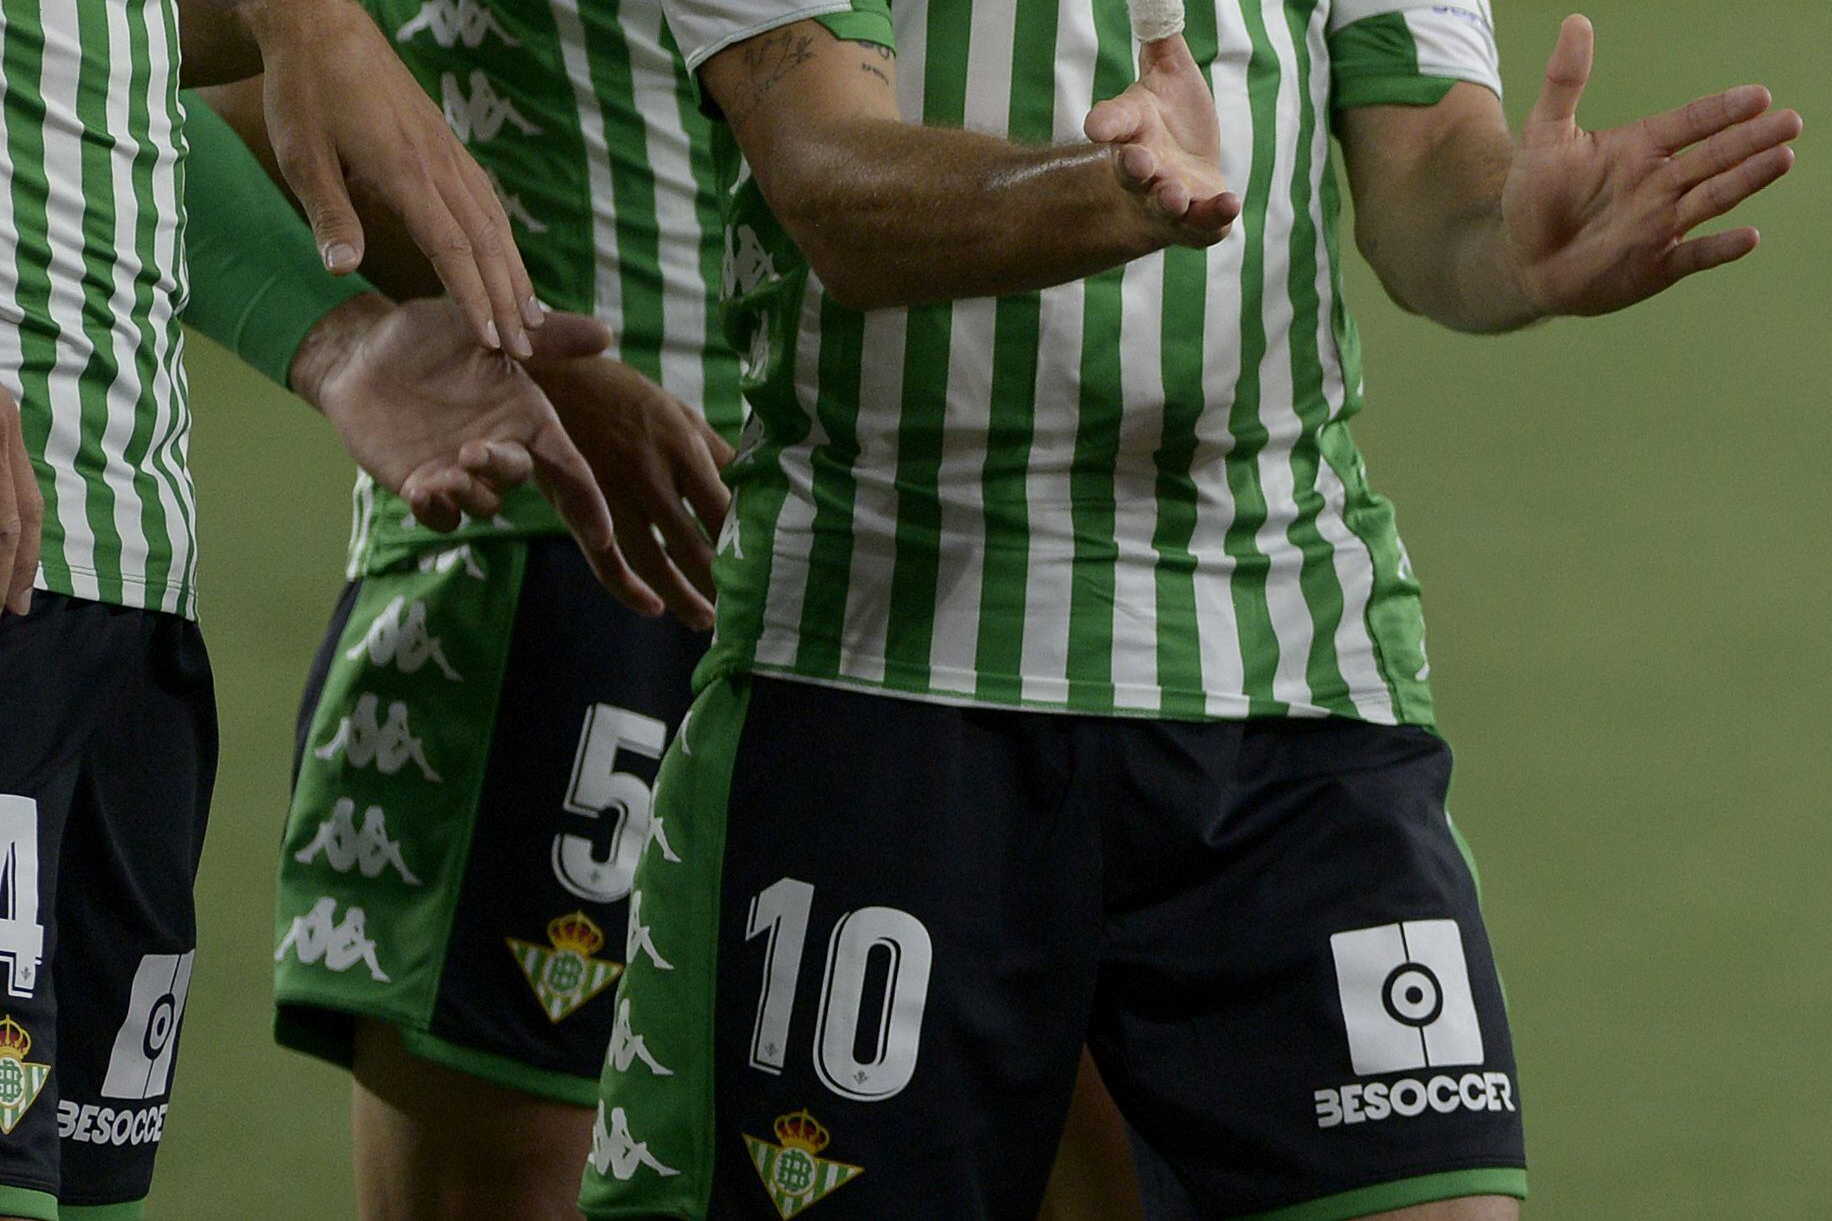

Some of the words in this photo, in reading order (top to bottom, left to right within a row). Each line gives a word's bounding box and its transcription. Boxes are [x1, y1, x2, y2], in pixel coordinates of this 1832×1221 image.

[0, 794, 44, 999] 4
[551, 701, 668, 904] 5
[745, 877, 933, 1102] 10
[1314, 1072, 1516, 1128] BESOCCER
